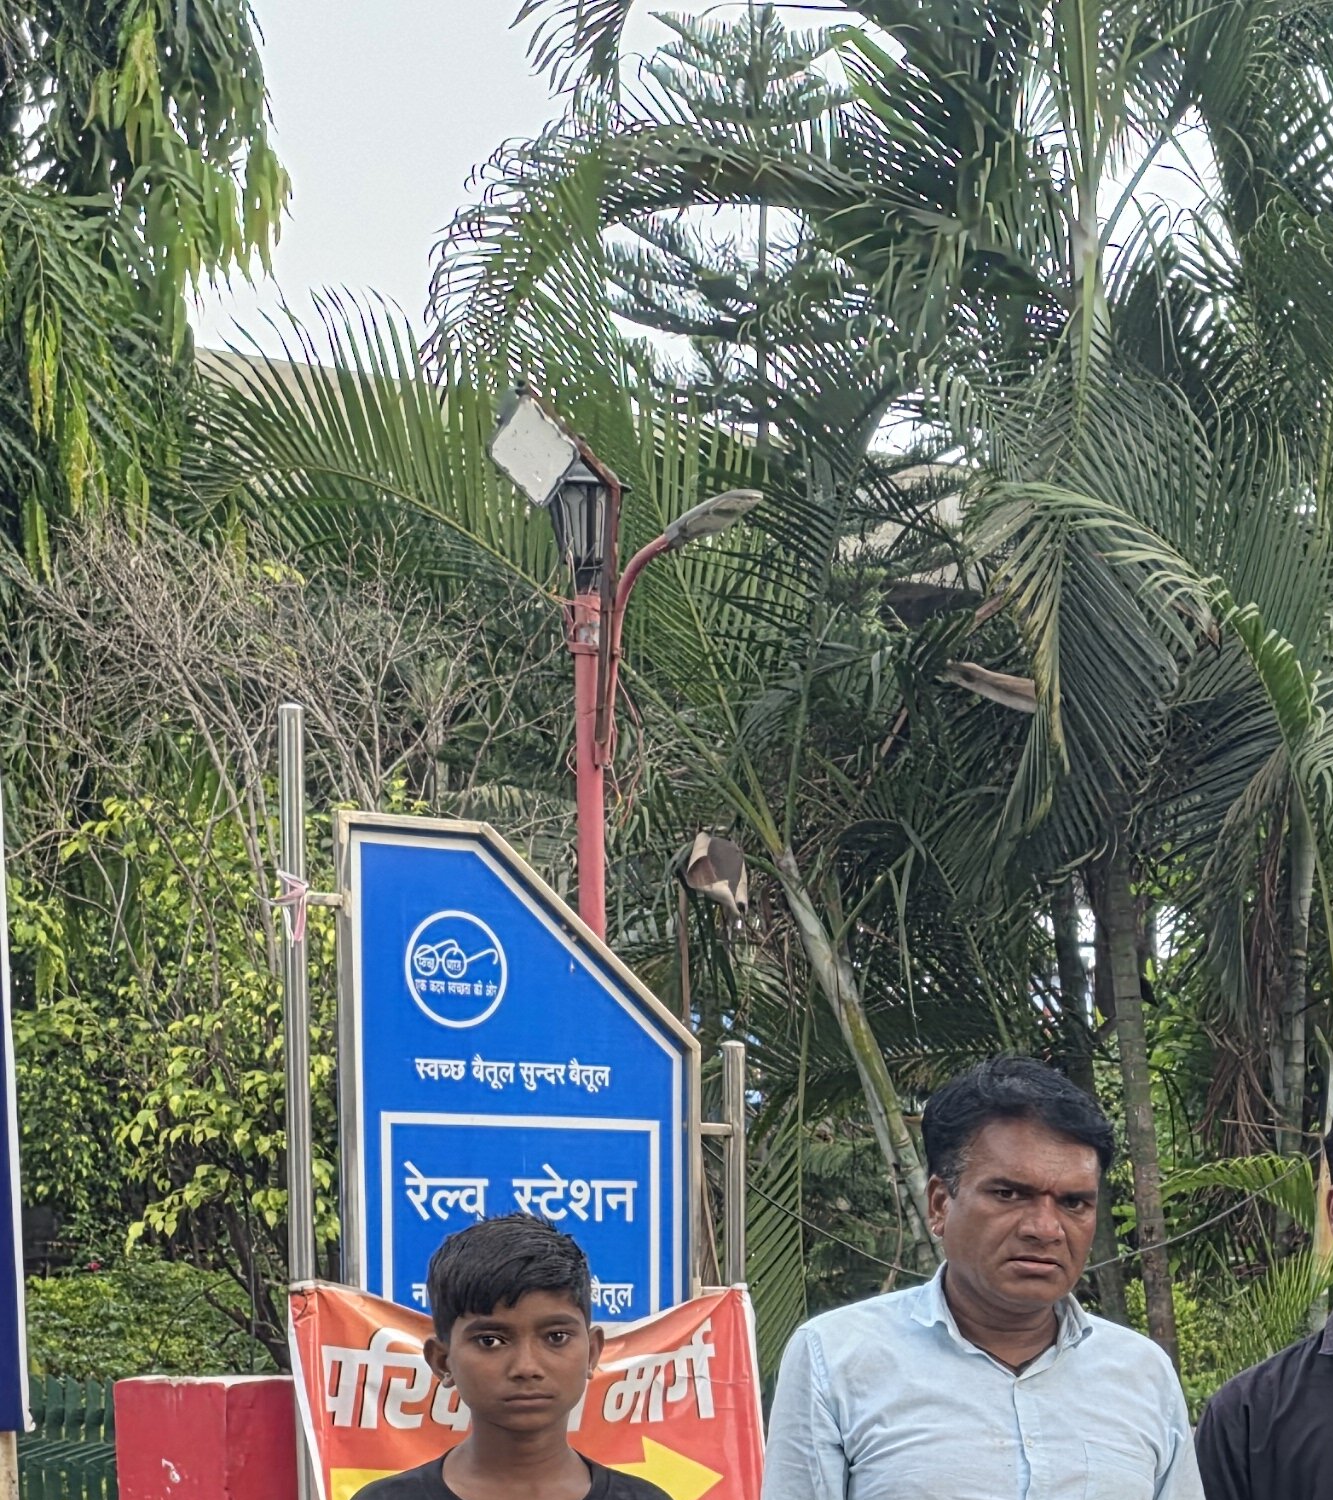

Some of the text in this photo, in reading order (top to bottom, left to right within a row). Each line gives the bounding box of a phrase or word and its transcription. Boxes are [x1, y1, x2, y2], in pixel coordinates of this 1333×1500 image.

[414, 1054, 610, 1092] स्वच्छ बैतूल सुन्दर बैतूल
[512, 1163, 638, 1222] स्टेशन
[602, 1318, 716, 1424] मार्ग
